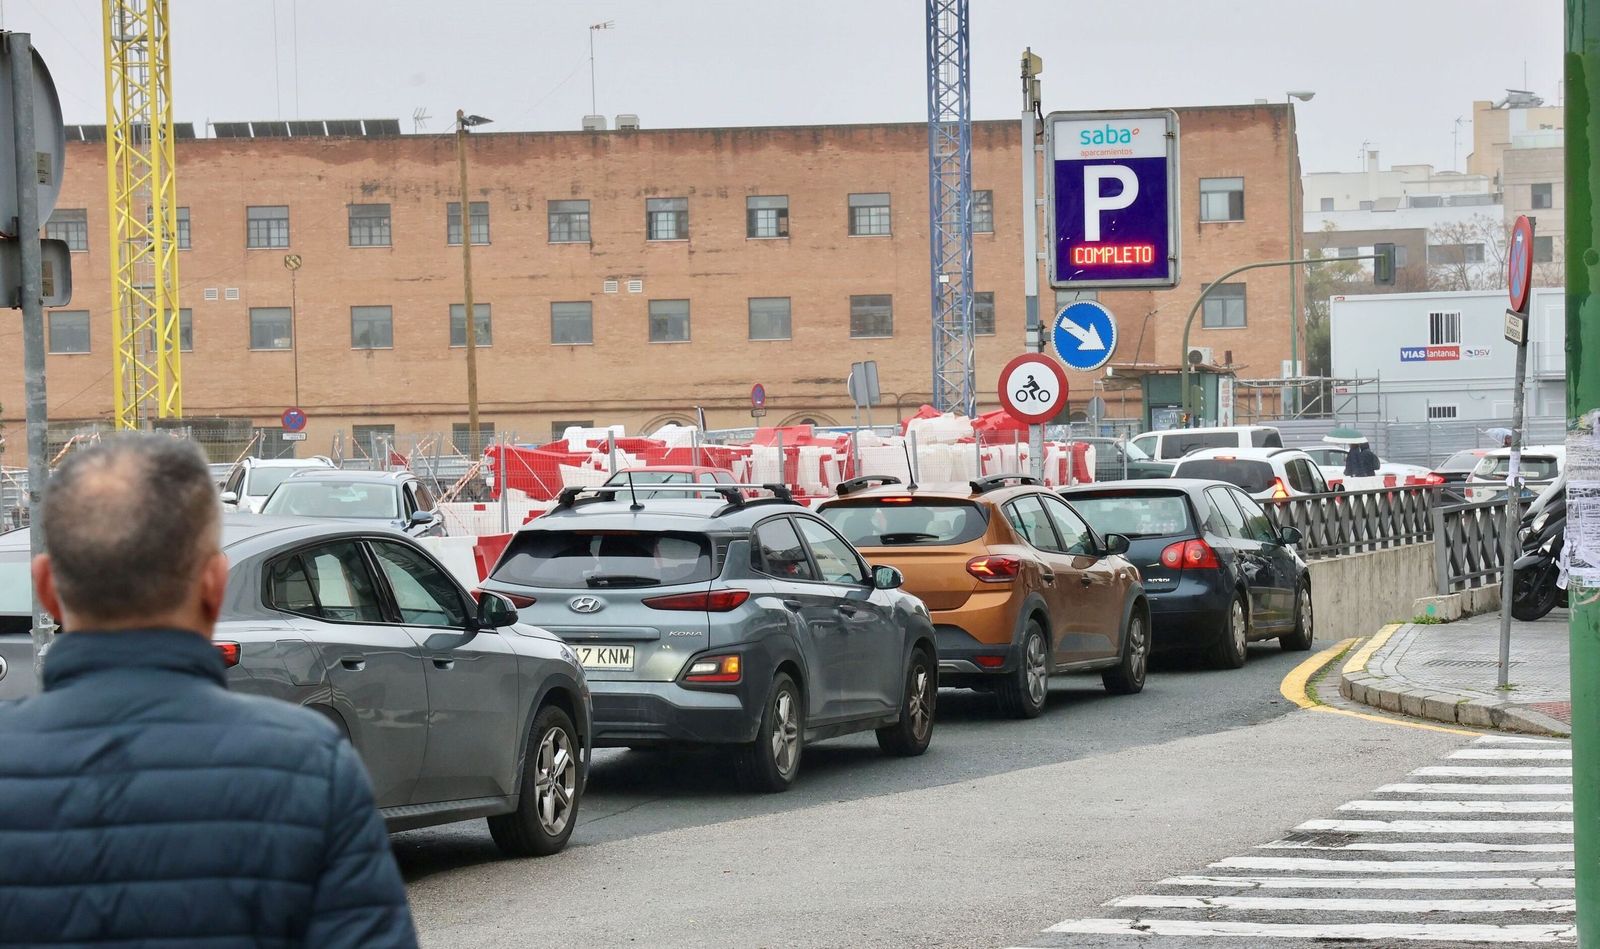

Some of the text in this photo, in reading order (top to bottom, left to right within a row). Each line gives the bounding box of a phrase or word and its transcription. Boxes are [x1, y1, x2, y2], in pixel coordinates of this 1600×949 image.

[1080, 124, 1131, 145] saba
[1080, 148, 1133, 158] aparcamientos
[1083, 164, 1139, 242] P
[1074, 246, 1152, 264] COMPLETO
[1402, 351, 1425, 359] VIAS
[597, 649, 630, 664] KNM
